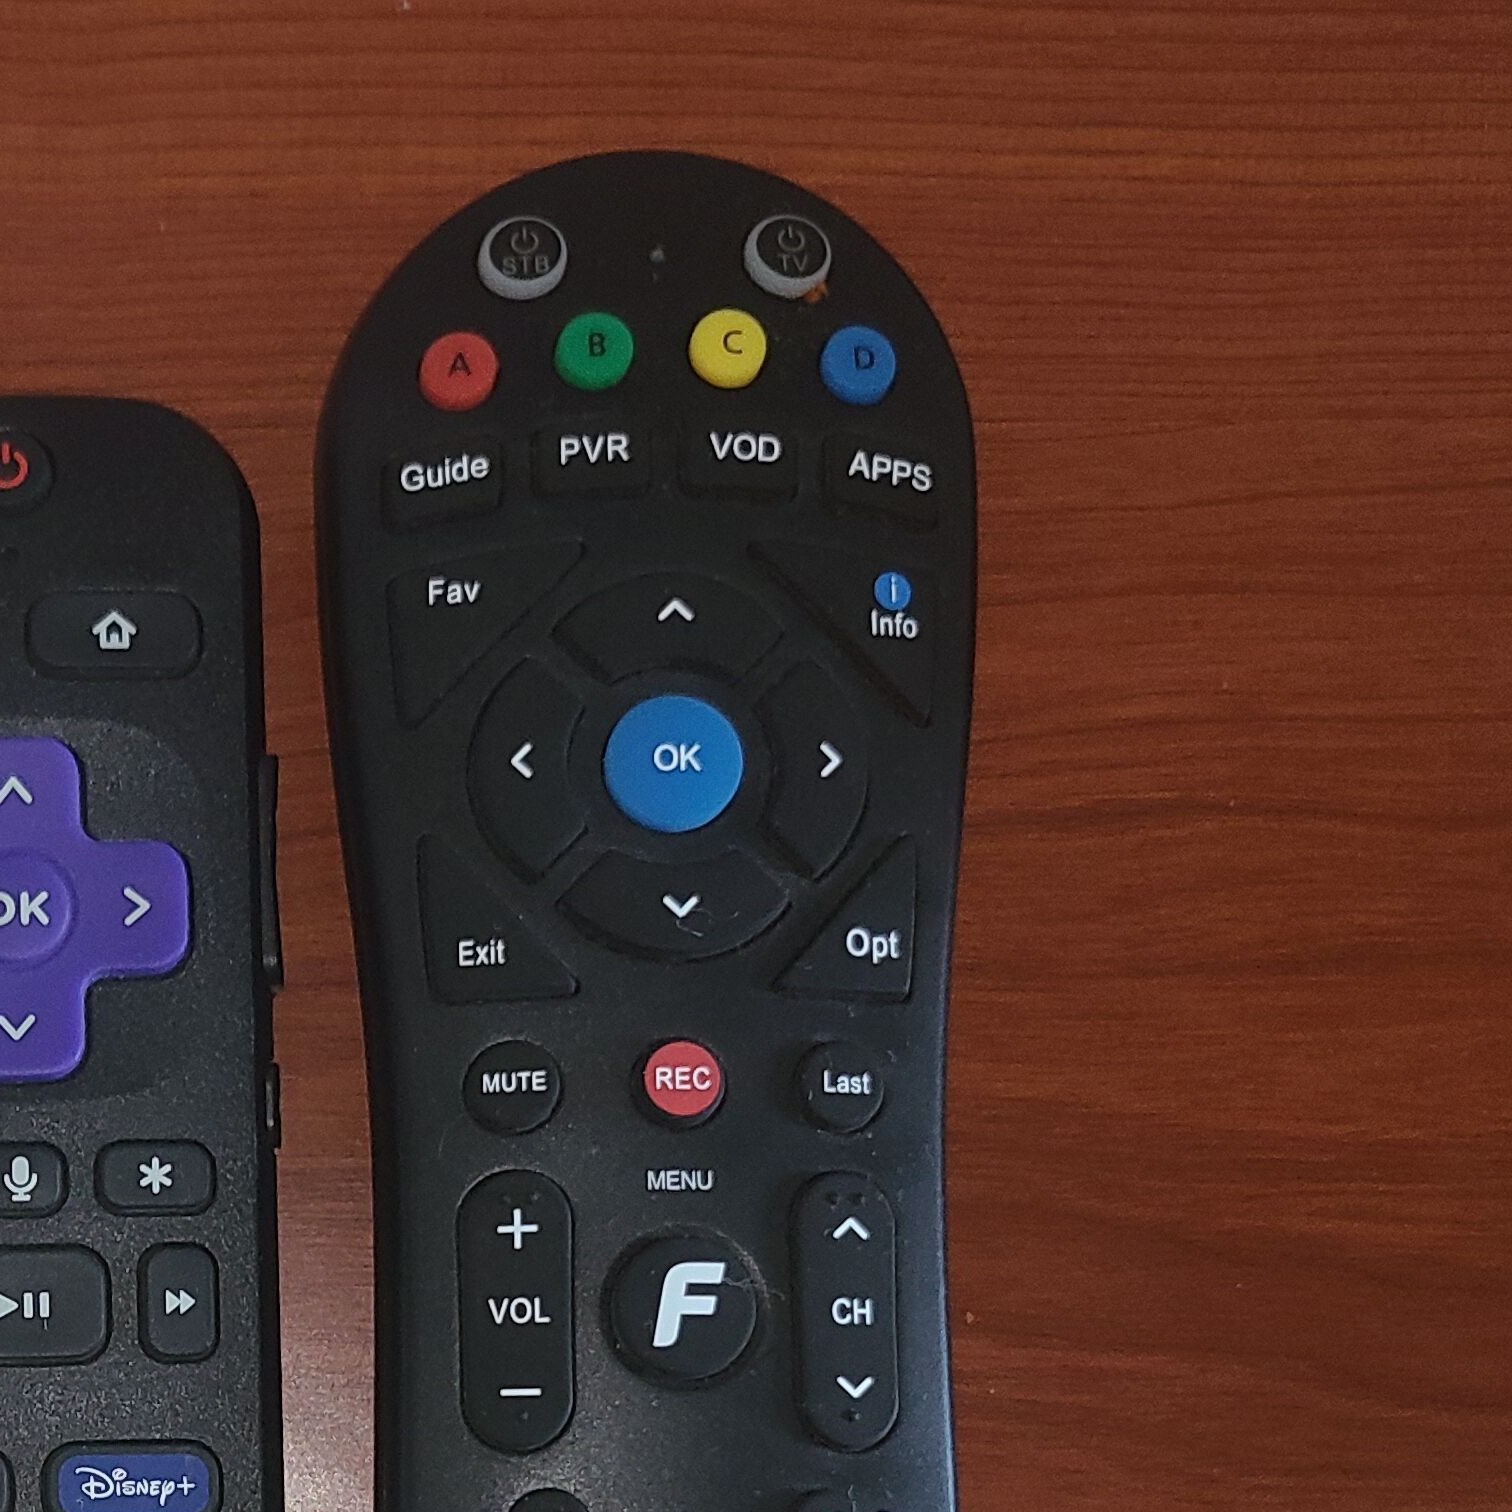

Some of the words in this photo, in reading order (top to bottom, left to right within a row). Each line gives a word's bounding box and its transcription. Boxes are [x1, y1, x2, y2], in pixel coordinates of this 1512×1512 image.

[500, 253, 551, 276] STB
[776, 252, 810, 273] TV
[588, 332, 608, 358] B
[722, 329, 744, 355] C
[447, 350, 473, 378] A
[853, 345, 877, 370] D
[560, 433, 630, 466] PVR
[709, 431, 782, 463] VOD
[400, 453, 490, 492] Guide
[848, 449, 932, 492] APPS
[428, 579, 481, 606] Fav
[871, 608, 919, 639] Info
[653, 743, 702, 772] OK
[458, 938, 506, 967] Exit
[846, 927, 900, 964] Opt
[482, 1069, 548, 1094] MUTE
[654, 1066, 714, 1092] REC
[823, 1069, 871, 1095] Last
[647, 1169, 713, 1191] MENU
[487, 1297, 551, 1325] VOL
[652, 1261, 726, 1348] F
[831, 1297, 873, 1326] CH
